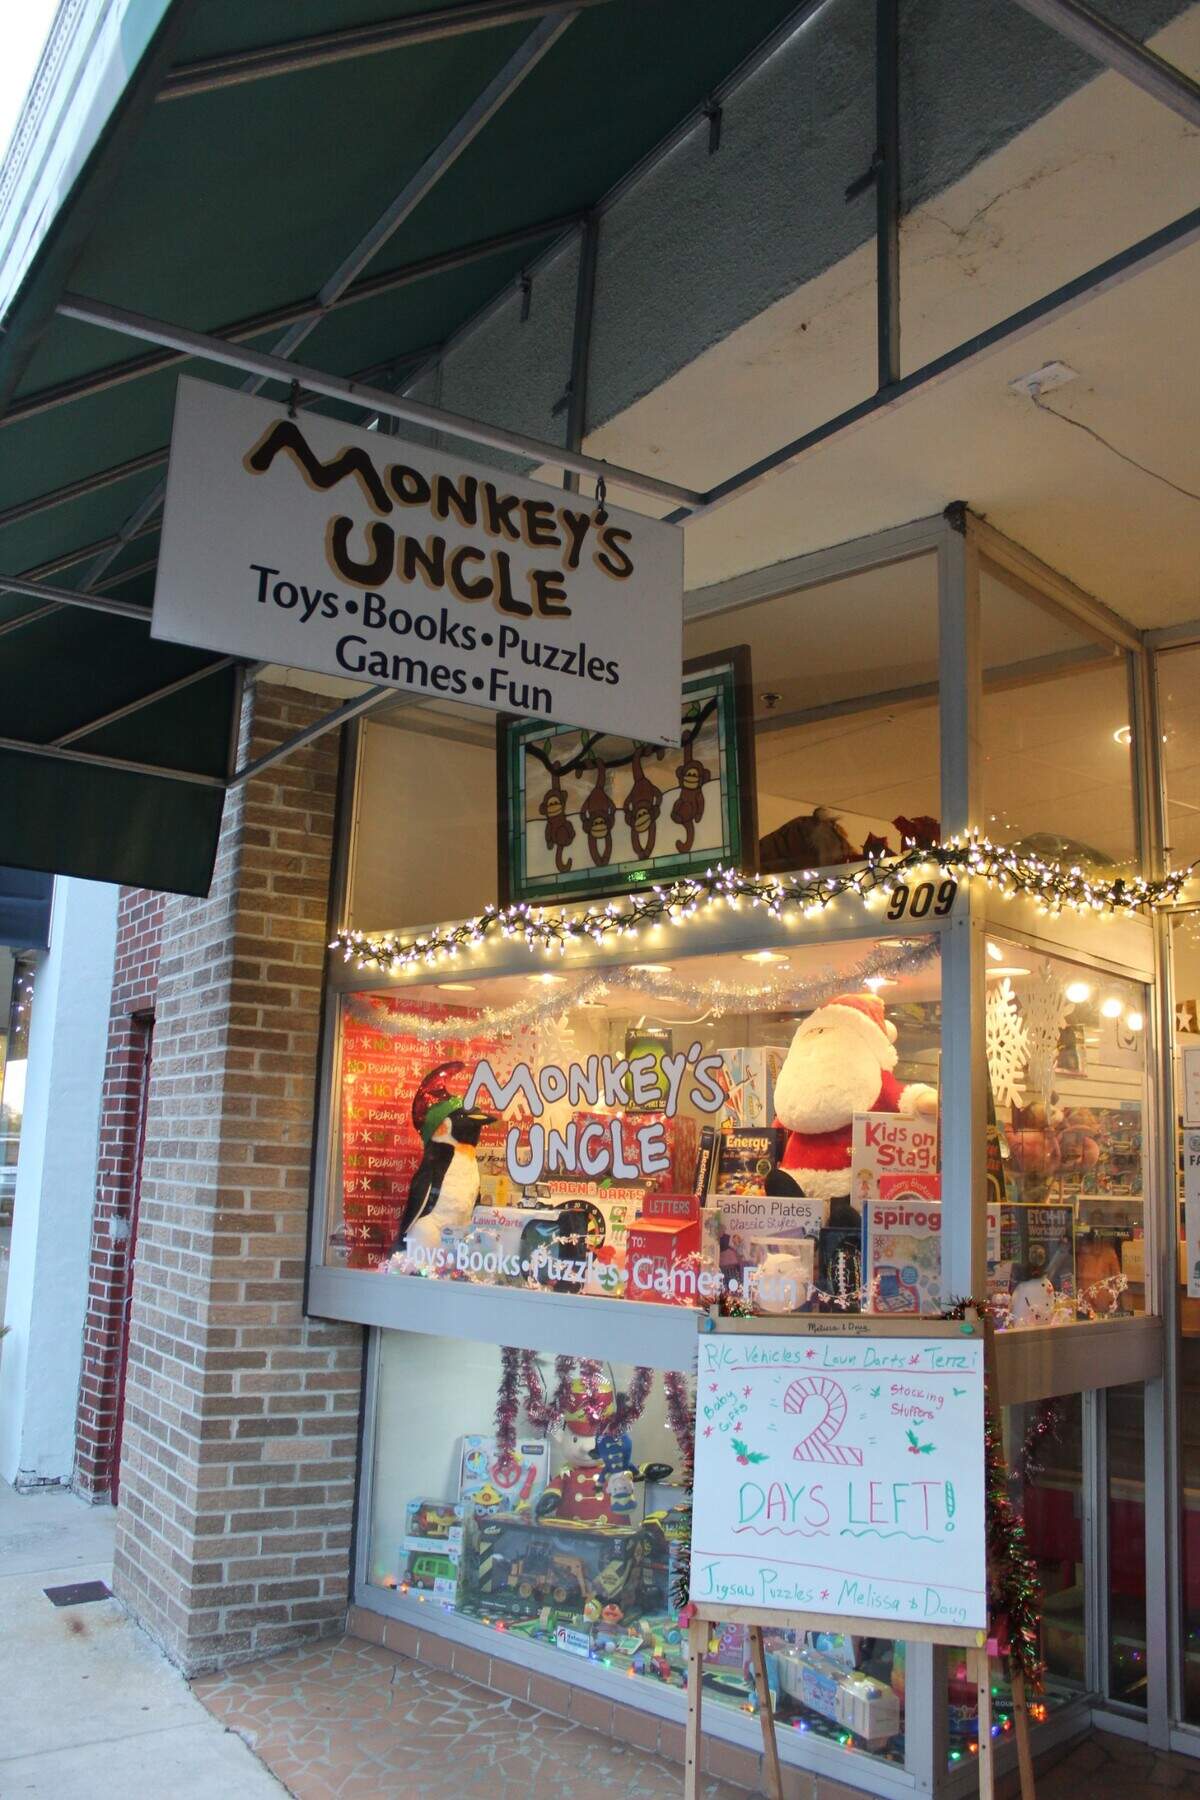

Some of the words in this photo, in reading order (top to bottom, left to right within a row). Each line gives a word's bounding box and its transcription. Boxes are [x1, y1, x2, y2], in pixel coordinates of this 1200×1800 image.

[242, 419, 635, 582] MONKEY'S
[325, 513, 573, 621] UNCLE
[249, 564, 339, 623] Toys
[363, 591, 478, 651] Books
[499, 624, 621, 686] Puzzles
[335, 634, 467, 695] Games
[488, 668, 553, 714] Fun
[887, 879, 958, 921] 909
[463, 1041, 726, 1118] MONKEY'S
[505, 1118, 672, 1187] UNCLE
[726, 1136, 769, 1150] Energy
[865, 1120, 908, 1147] Kids
[912, 1132, 936, 1148] on
[649, 1199, 690, 1215] LETTERS
[717, 1200, 766, 1215] Fashion
[770, 1202, 813, 1218] Plates
[456, 1241, 521, 1277] Books
[531, 1249, 619, 1285] Puzzles
[632, 1257, 724, 1297] Games
[704, 1343, 737, 1367] R/C
[745, 1345, 801, 1364] Vehicles
[703, 1390, 738, 1421] Baby
[783, 1376, 864, 1467] 2
[890, 1383, 945, 1410] Stocking
[737, 1481, 831, 1527] DAYS
[848, 1480, 957, 1533] LEFT!
[700, 1561, 755, 1600] Jigsaw
[758, 1568, 814, 1604] Puzzles
[837, 1579, 900, 1611] Melissa
[923, 1587, 968, 1623] Doug
